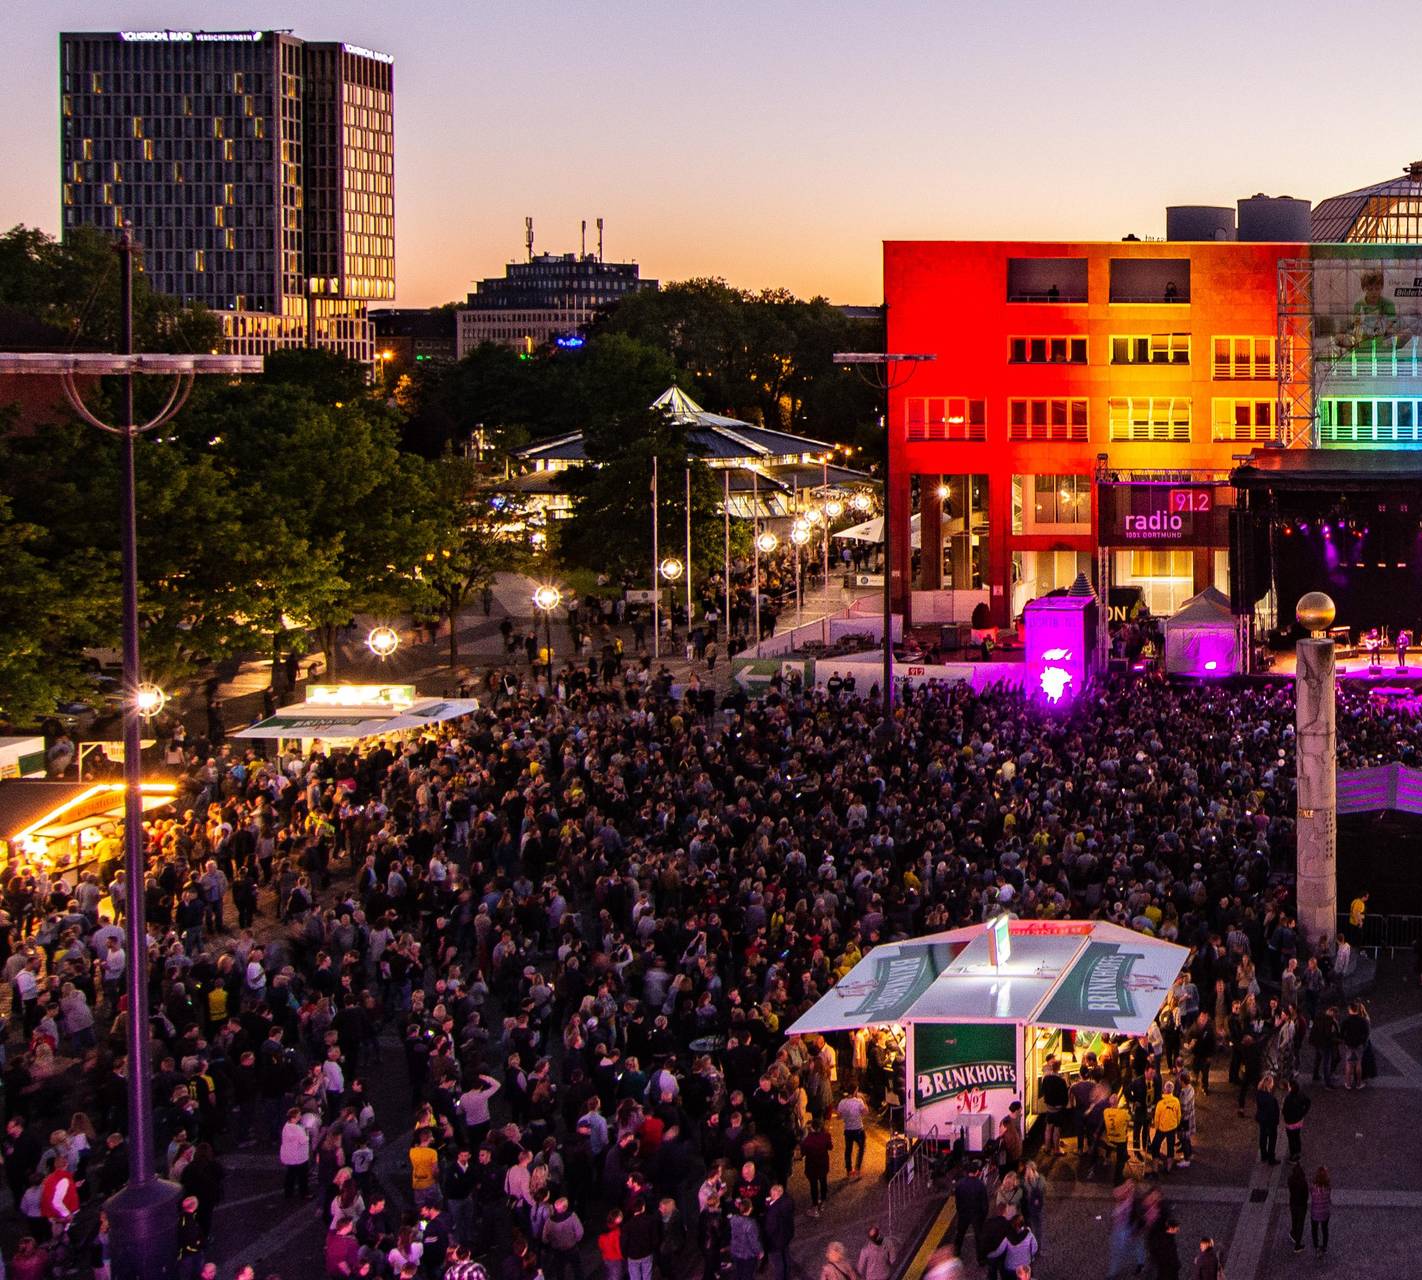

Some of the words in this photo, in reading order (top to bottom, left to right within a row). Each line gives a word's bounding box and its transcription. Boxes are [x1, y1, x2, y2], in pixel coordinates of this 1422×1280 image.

[169, 31, 193, 41] BUND
[1175, 493, 1209, 512] 91.2
[1125, 511, 1182, 530] radio
